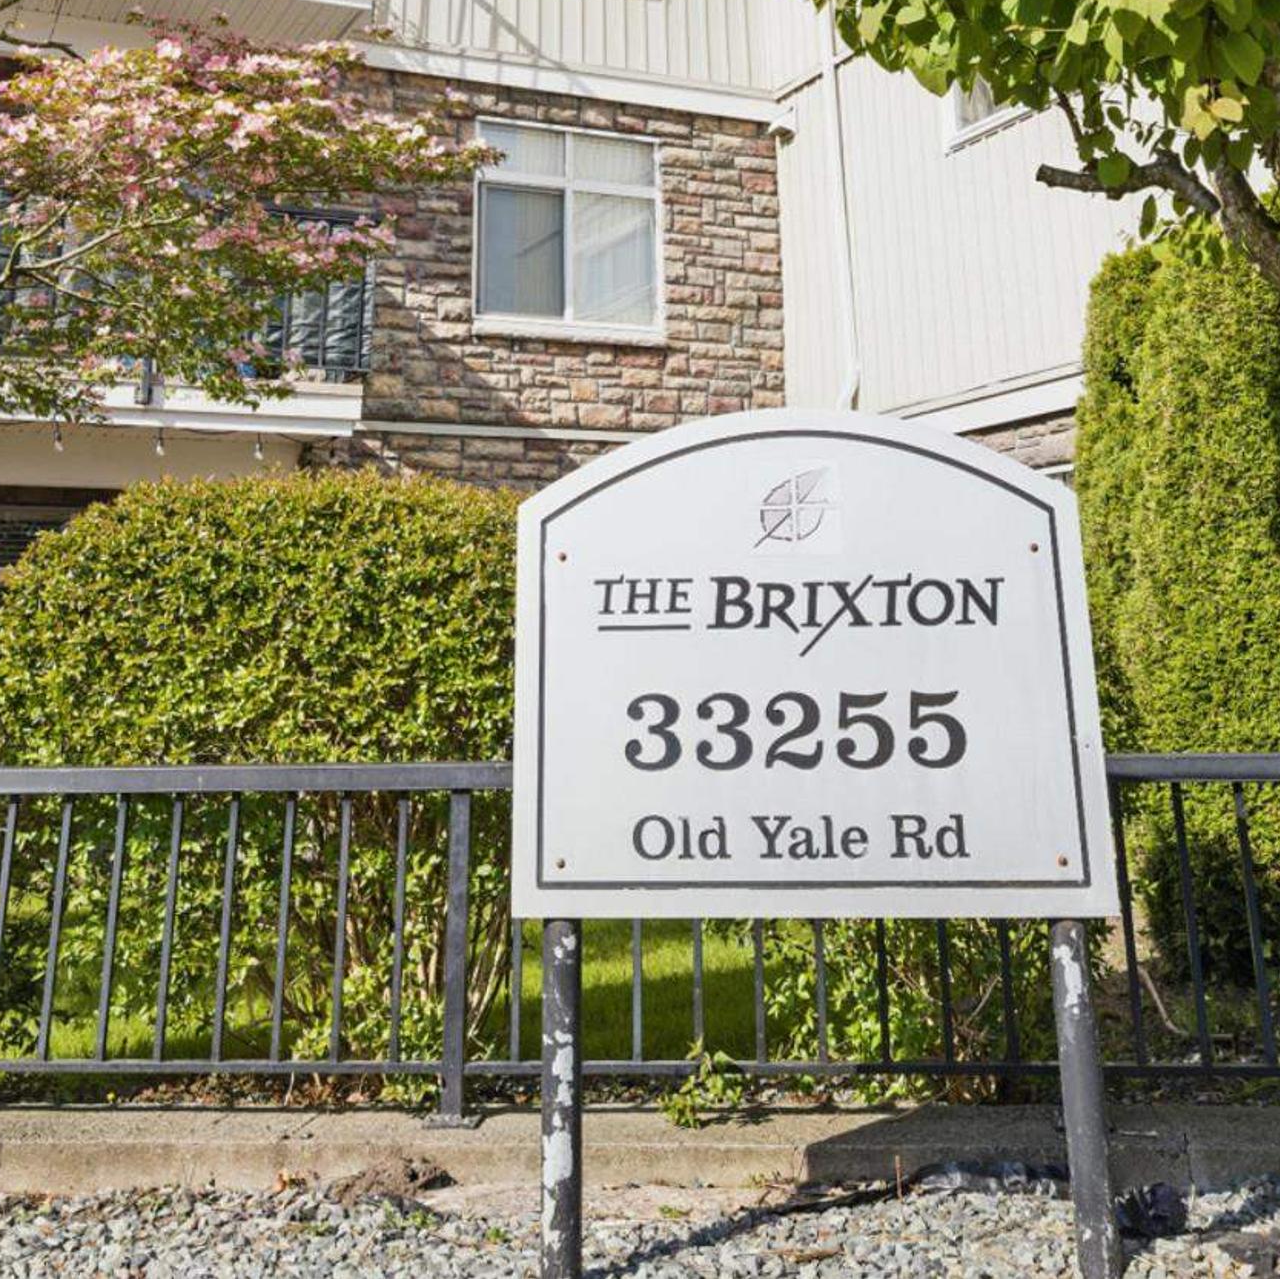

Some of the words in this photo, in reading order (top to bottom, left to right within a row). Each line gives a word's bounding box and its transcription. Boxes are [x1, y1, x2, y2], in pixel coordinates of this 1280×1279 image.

[595, 575, 693, 614] THE
[707, 573, 1004, 656] BRIXTON
[625, 691, 966, 771] 33255
[633, 815, 731, 860] Old
[751, 815, 868, 860] Yale
[891, 814, 970, 859] Rd
